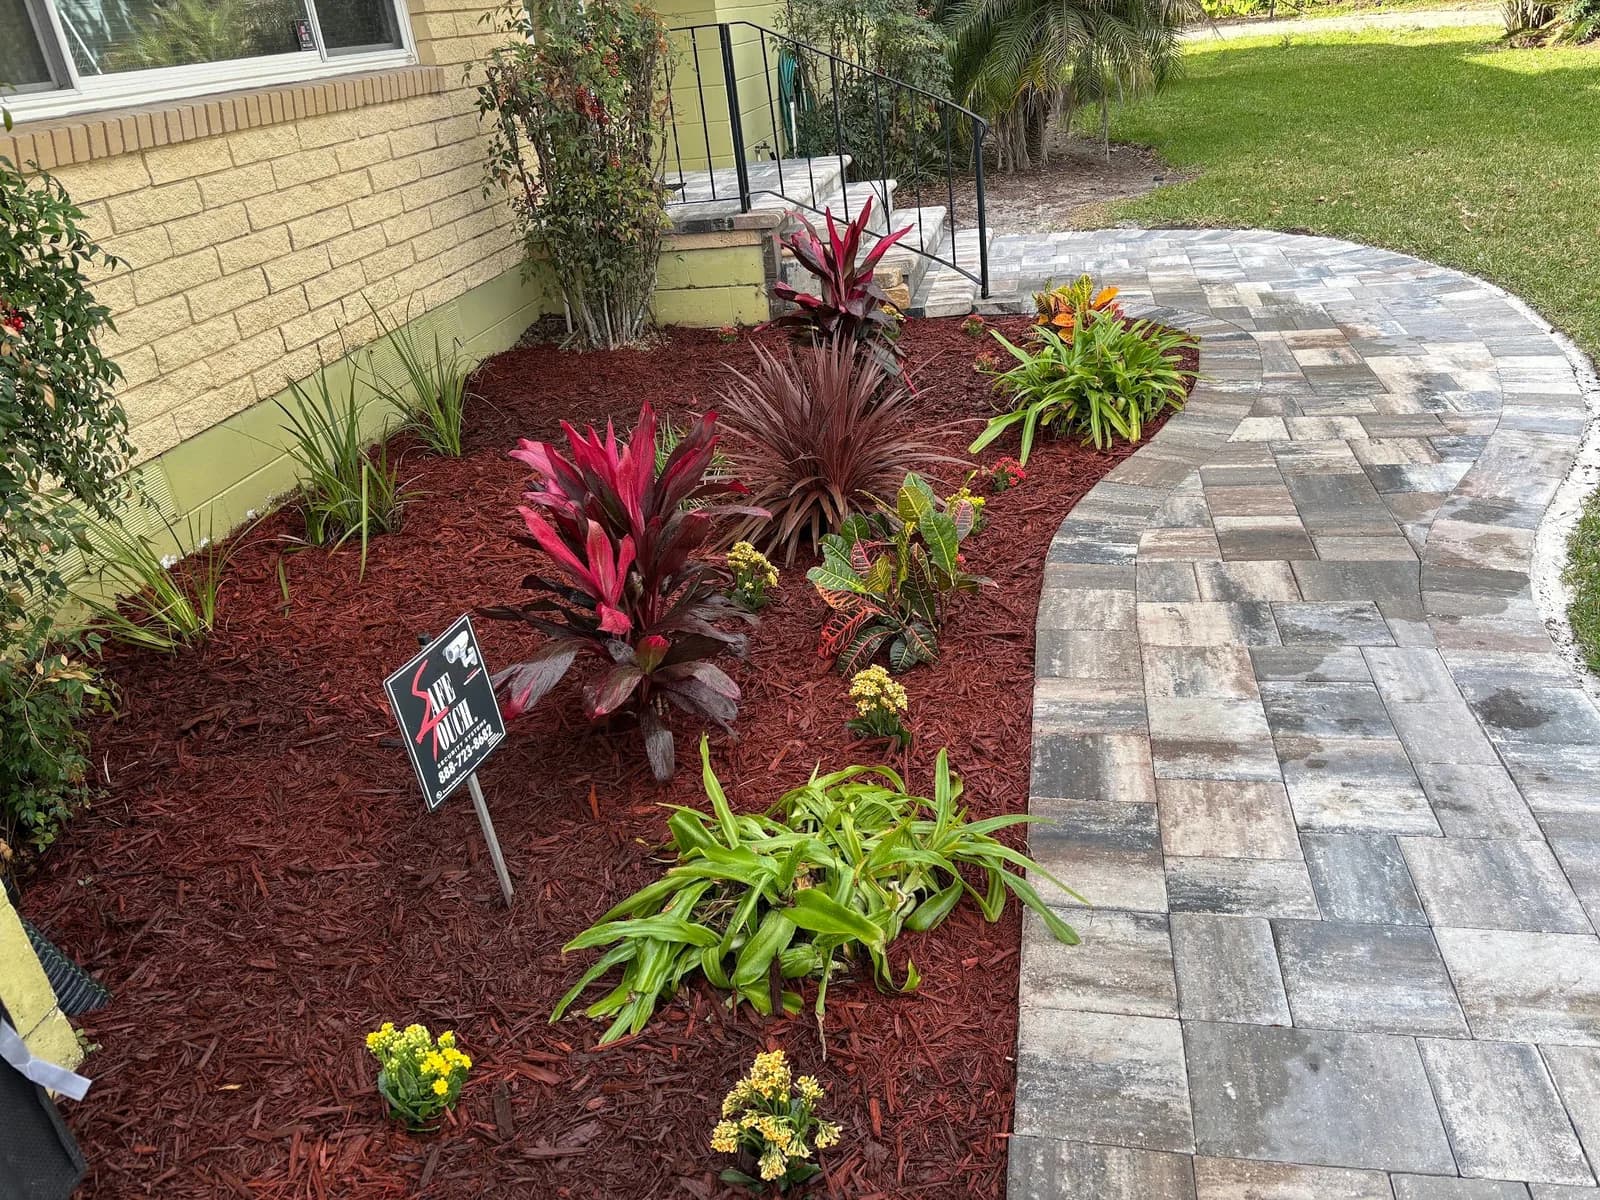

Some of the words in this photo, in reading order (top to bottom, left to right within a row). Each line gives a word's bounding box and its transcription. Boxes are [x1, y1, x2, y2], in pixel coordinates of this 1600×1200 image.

[412, 659, 457, 738] SAFE
[437, 741, 464, 769] SECURITY
[464, 719, 488, 743] SYSTEMS
[438, 724, 494, 784] 888-723-8682
